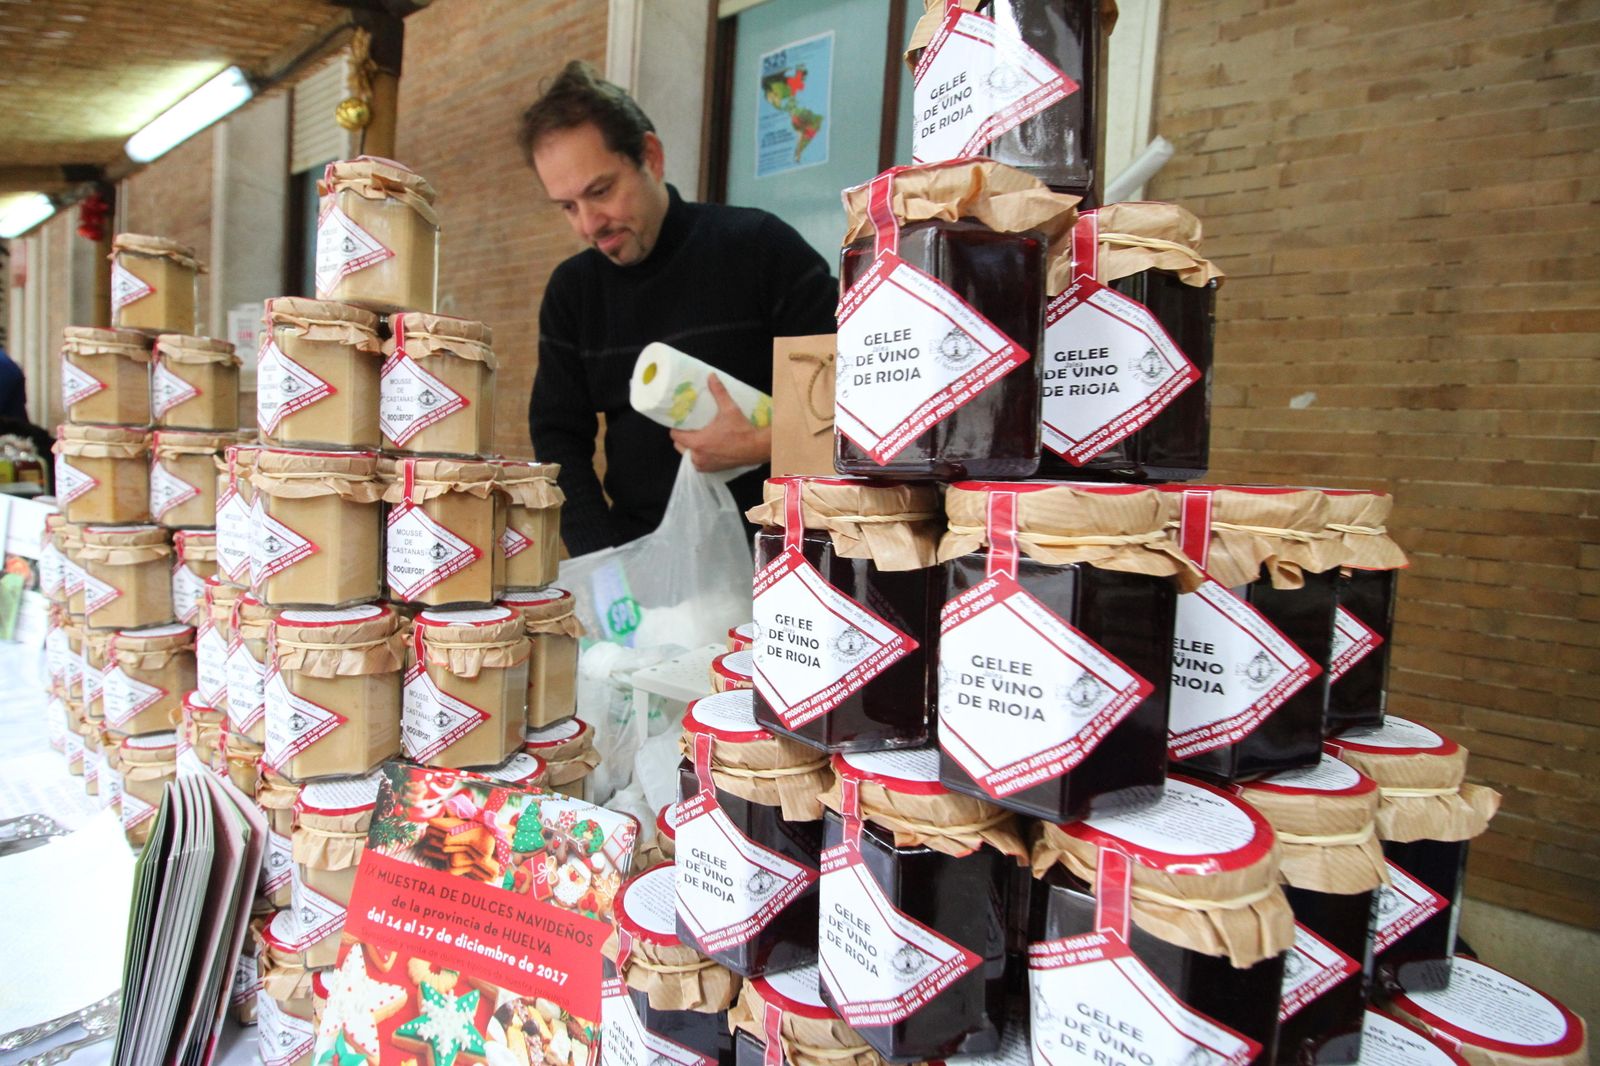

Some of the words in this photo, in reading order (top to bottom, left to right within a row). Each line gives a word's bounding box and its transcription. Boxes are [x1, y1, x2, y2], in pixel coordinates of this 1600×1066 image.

[930, 71, 967, 100] GELEE
[923, 106, 938, 121] DE
[941, 86, 972, 110] VINO
[921, 124, 936, 138] DE
[939, 104, 973, 129] RIOJA
[864, 328, 911, 346] GELEE
[856, 355, 873, 367] DE
[879, 347, 920, 362] VINO
[1055, 347, 1109, 362] GELEE
[854, 374, 871, 386] DE
[876, 368, 921, 382] RIOJA
[1045, 368, 1066, 379] DE
[1073, 365, 1118, 378] VINO
[1042, 386, 1063, 397] DE
[1069, 382, 1120, 396] RIOJA
[396, 529, 422, 537] MOUSSE
[393, 565, 425, 575] ROQUEFORT
[775, 614, 813, 631] GELEE
[769, 629, 784, 641] DE
[787, 632, 819, 649] VINO
[1172, 638, 1215, 655] ELEE
[767, 645, 782, 657] DE
[785, 649, 821, 668] RIOJA
[971, 655, 1033, 676] GELEE
[1172, 657, 1223, 674] VINO
[850, 678, 863, 691] UNA
[863, 670, 876, 682] VEZ
[876, 648, 905, 672] ABIERTO.
[409, 690, 428, 702] MOUSSE
[961, 673, 985, 689] DE
[992, 679, 1043, 699] VINO
[1171, 675, 1225, 695] RIOJA
[958, 693, 982, 708] DE
[989, 698, 1045, 722] RIOJA
[692, 848, 727, 870] GELEE
[685, 859, 700, 872] DE
[703, 866, 733, 887] VINO
[684, 873, 698, 887] DE
[702, 881, 735, 904] RIOJA
[365, 863, 375, 877] IX
[377, 870, 436, 897] MUESTRA
[440, 888, 458, 902] DE
[461, 893, 514, 919] DULCES
[515, 910, 594, 948] NAVIDEÑOS
[746, 925, 760, 941] FRÍO
[760, 916, 772, 927] UNA
[772, 904, 784, 916] VEZ
[784, 880, 810, 903] ABIERTO.
[391, 895, 407, 908] de
[412, 899, 421, 914] la
[423, 905, 480, 931] provincia
[483, 921, 499, 937] de
[502, 927, 552, 956] HUELVA
[834, 904, 871, 936] GELEE
[367, 907, 385, 925] del
[387, 915, 401, 931] 14
[403, 919, 416, 933] al
[418, 923, 434, 940] 17
[436, 929, 452, 944] de
[455, 934, 516, 966] diciembre
[519, 956, 534, 973] de
[536, 960, 569, 986] 2017
[828, 915, 843, 931] DE
[846, 926, 878, 957] VINO
[827, 930, 842, 948] DE
[845, 943, 879, 977] RIOJA
[906, 999, 922, 1015] UNA
[922, 987, 938, 1003] VEZ
[937, 966, 968, 990] ABIERTO.
[1499, 982, 1531, 997] VINO
[1077, 1002, 1145, 1042] GELEE
[612, 1021, 635, 1048] GELEE
[1060, 1035, 1086, 1055] DE
[1064, 1016, 1091, 1037] DE
[1098, 1028, 1154, 1066] VINO
[1392, 1035, 1426, 1051] VINO
[608, 1042, 618, 1052] DE
[610, 1030, 620, 1040] DE
[621, 1038, 638, 1066] VINO
